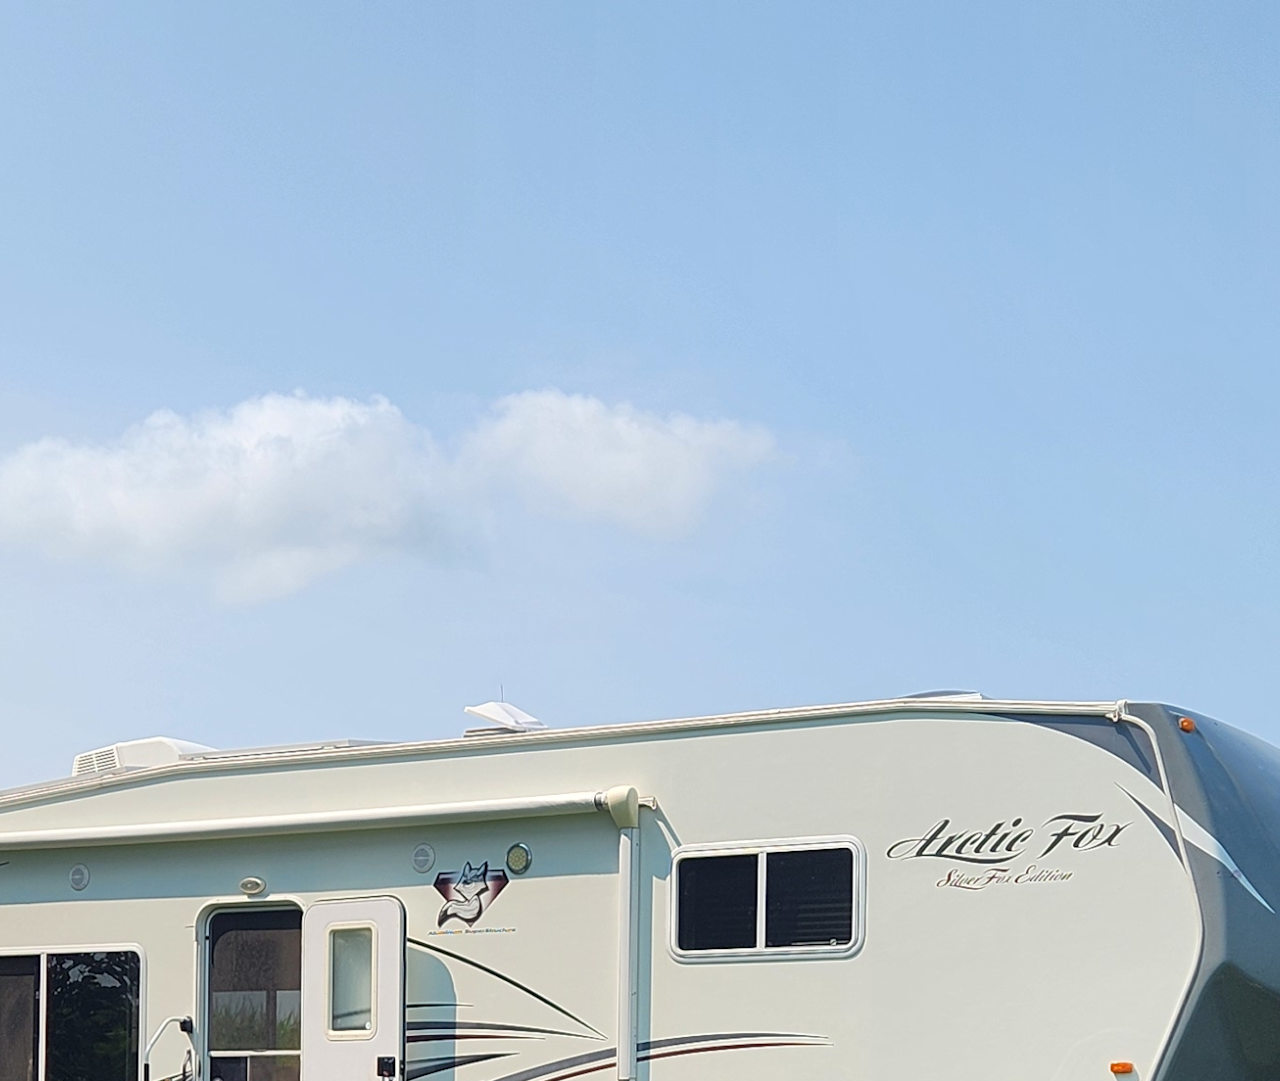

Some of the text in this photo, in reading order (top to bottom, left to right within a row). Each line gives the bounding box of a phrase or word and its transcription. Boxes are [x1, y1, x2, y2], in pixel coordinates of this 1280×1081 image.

[886, 813, 1134, 864] Arctic Fox
[936, 865, 1073, 890] Silver Fox Edition
